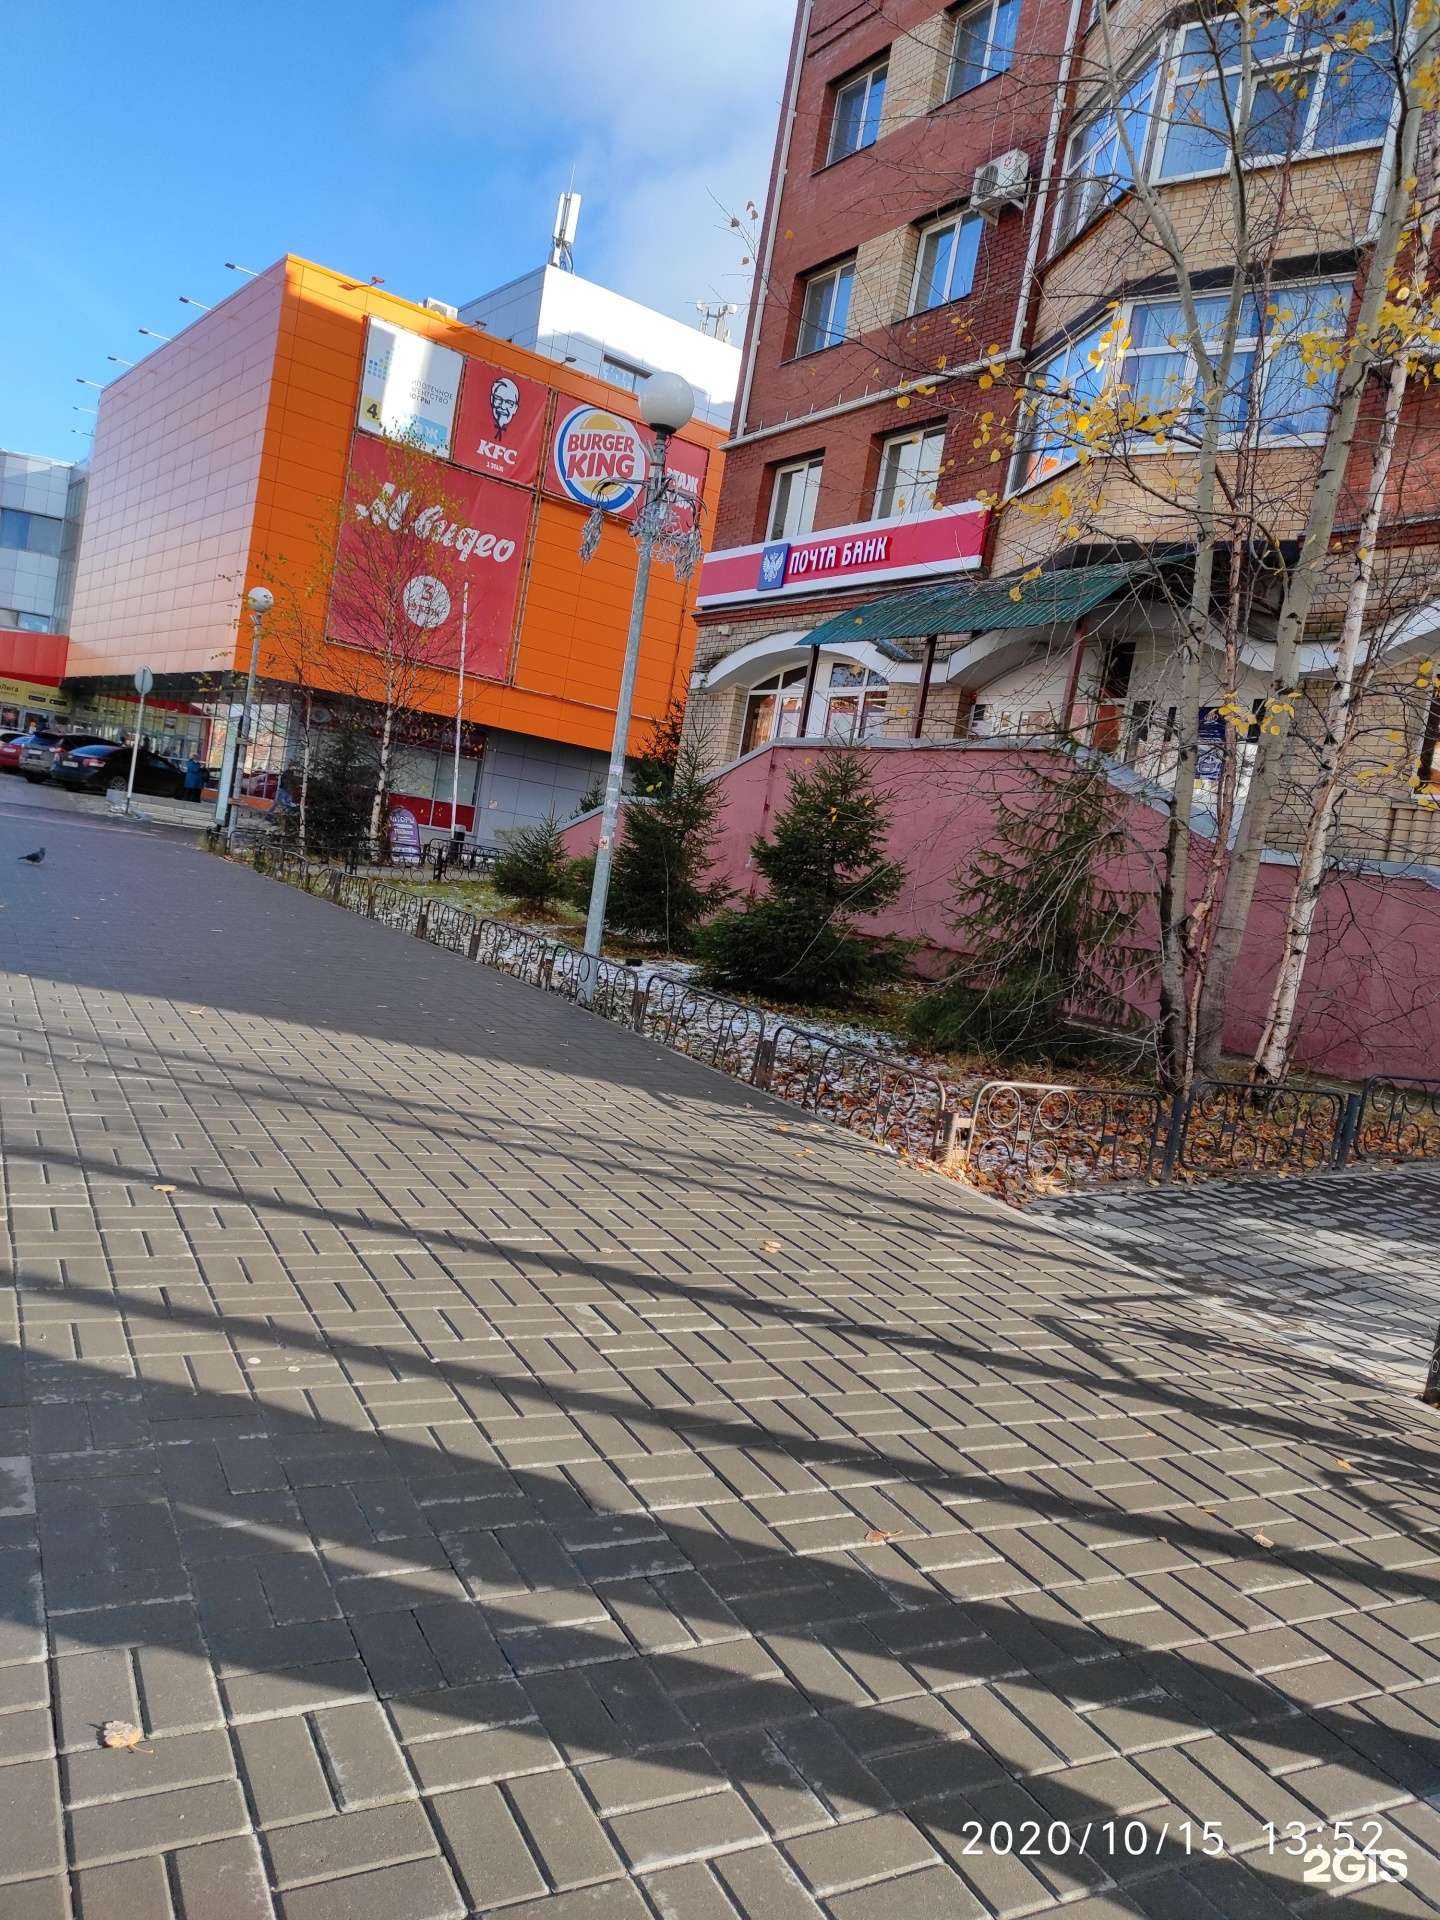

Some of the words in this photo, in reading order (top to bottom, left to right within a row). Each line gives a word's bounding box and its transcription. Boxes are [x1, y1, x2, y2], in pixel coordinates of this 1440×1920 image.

[476, 440, 518, 465] KFC
[567, 433, 634, 453] BURGER
[566, 453, 635, 481] KING
[789, 545, 837, 575] ПОЧТА
[841, 536, 892, 567] БАНК
[421, 583, 434, 601] 3
